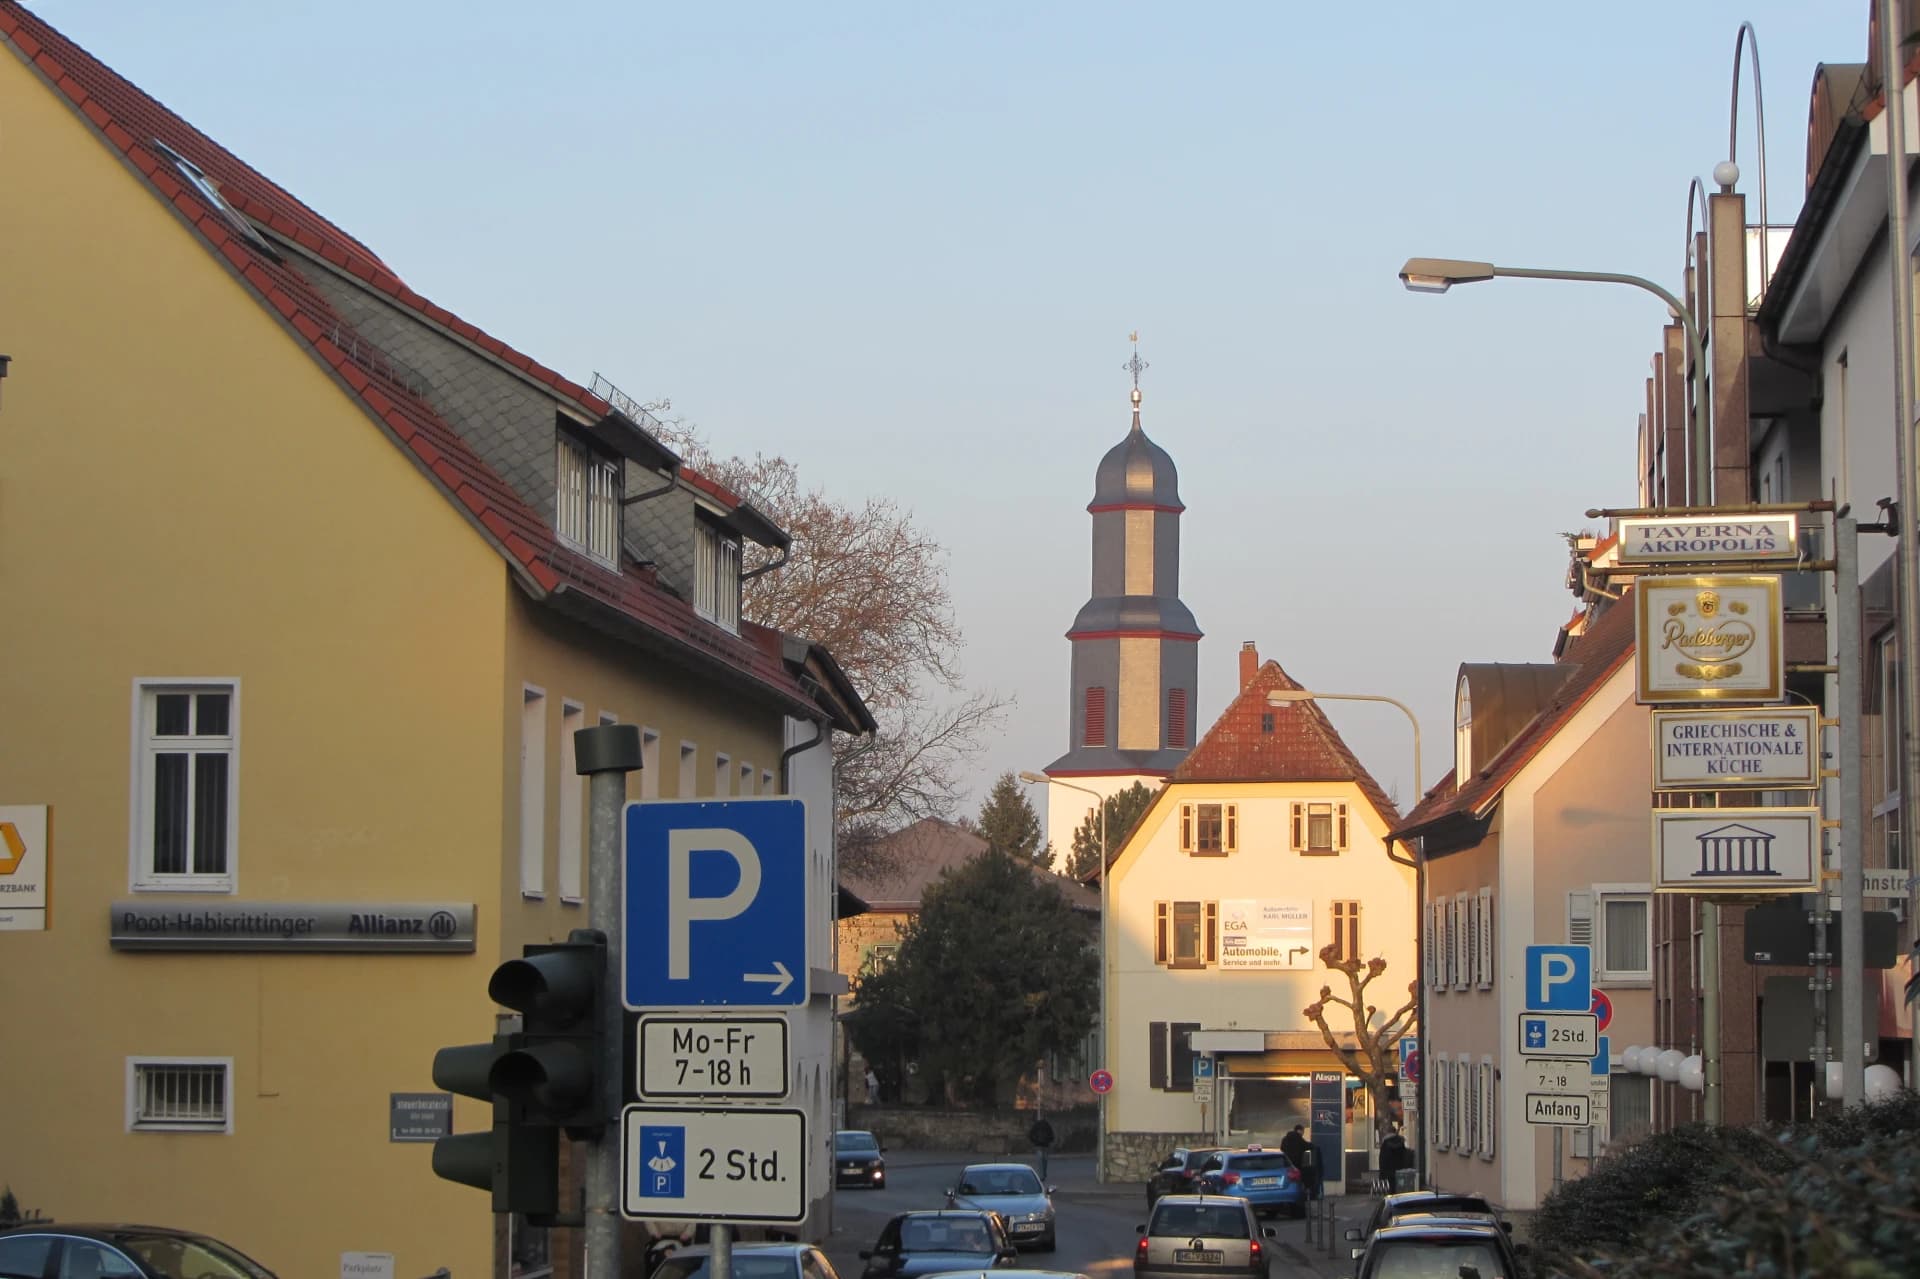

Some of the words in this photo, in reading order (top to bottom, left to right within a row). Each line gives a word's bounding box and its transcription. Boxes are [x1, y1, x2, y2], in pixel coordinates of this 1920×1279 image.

[1638, 524, 1774, 539] TAVERNA
[1640, 538, 1775, 553] AKROPOLIS
[1662, 618, 1756, 653] Radeberger
[1672, 723, 1780, 740] GRIECHISCHE
[1784, 723, 1796, 737] &
[1667, 741, 1804, 757] INTERNATIONALE
[1707, 757, 1762, 774] KÜCHE
[669, 828, 761, 980] P
[123, 912, 315, 937] Poot-Habisrittinger
[348, 914, 425, 935] Allianz
[1223, 946, 1282, 958] Automobile,
[1540, 953, 1576, 1003] P
[673, 1027, 755, 1054] Mo-Fr
[740, 1059, 751, 1085] h
[1535, 1100, 1581, 1121] Anfang
[699, 1148, 715, 1180] 2
[726, 1149, 786, 1182] Std.
